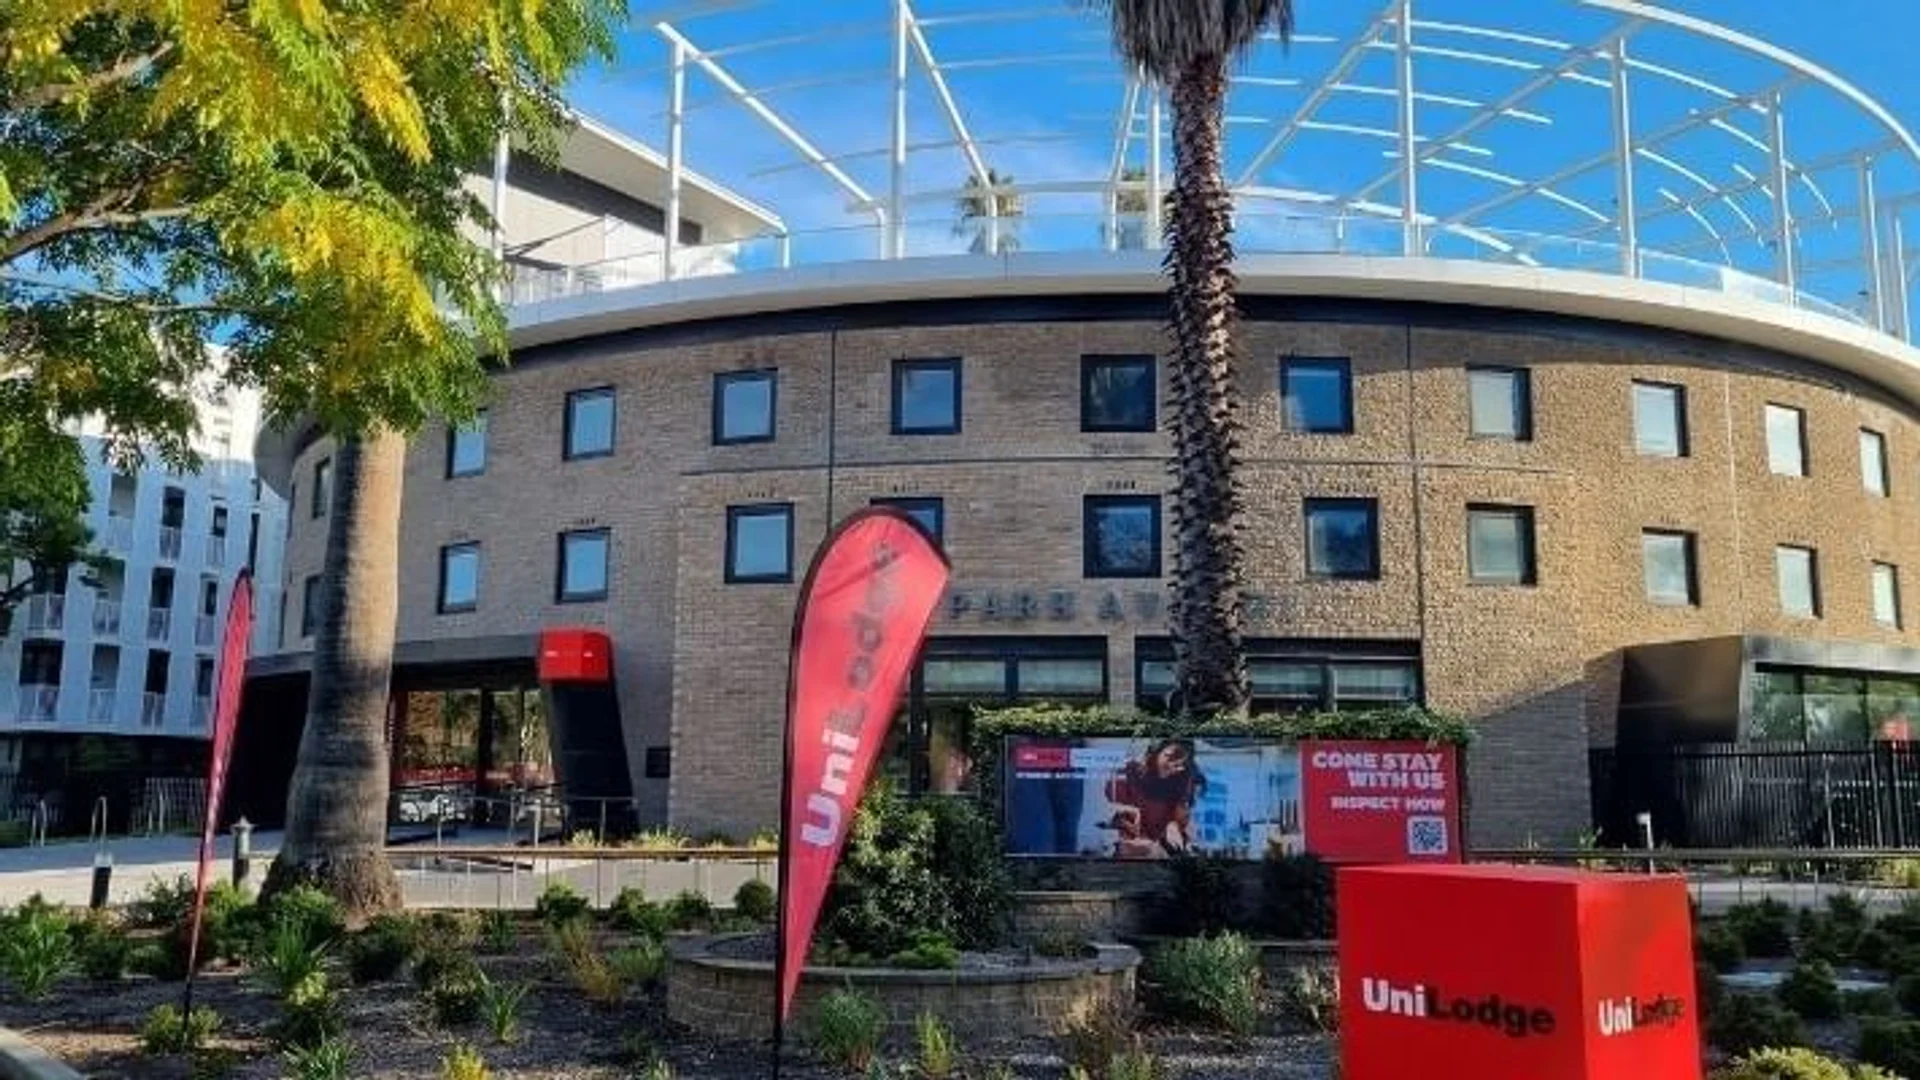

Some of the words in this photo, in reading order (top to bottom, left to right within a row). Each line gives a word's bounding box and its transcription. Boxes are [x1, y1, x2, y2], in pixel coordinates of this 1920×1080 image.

[1312, 751, 1379, 769] COME
[1381, 752, 1442, 771] STAY
[1348, 770, 1408, 789] WITH
[1411, 771, 1446, 790] US
[1330, 796, 1399, 810] INSPECT
[1405, 797, 1445, 812] NOW
[1361, 976, 1555, 1038] UniLodge
